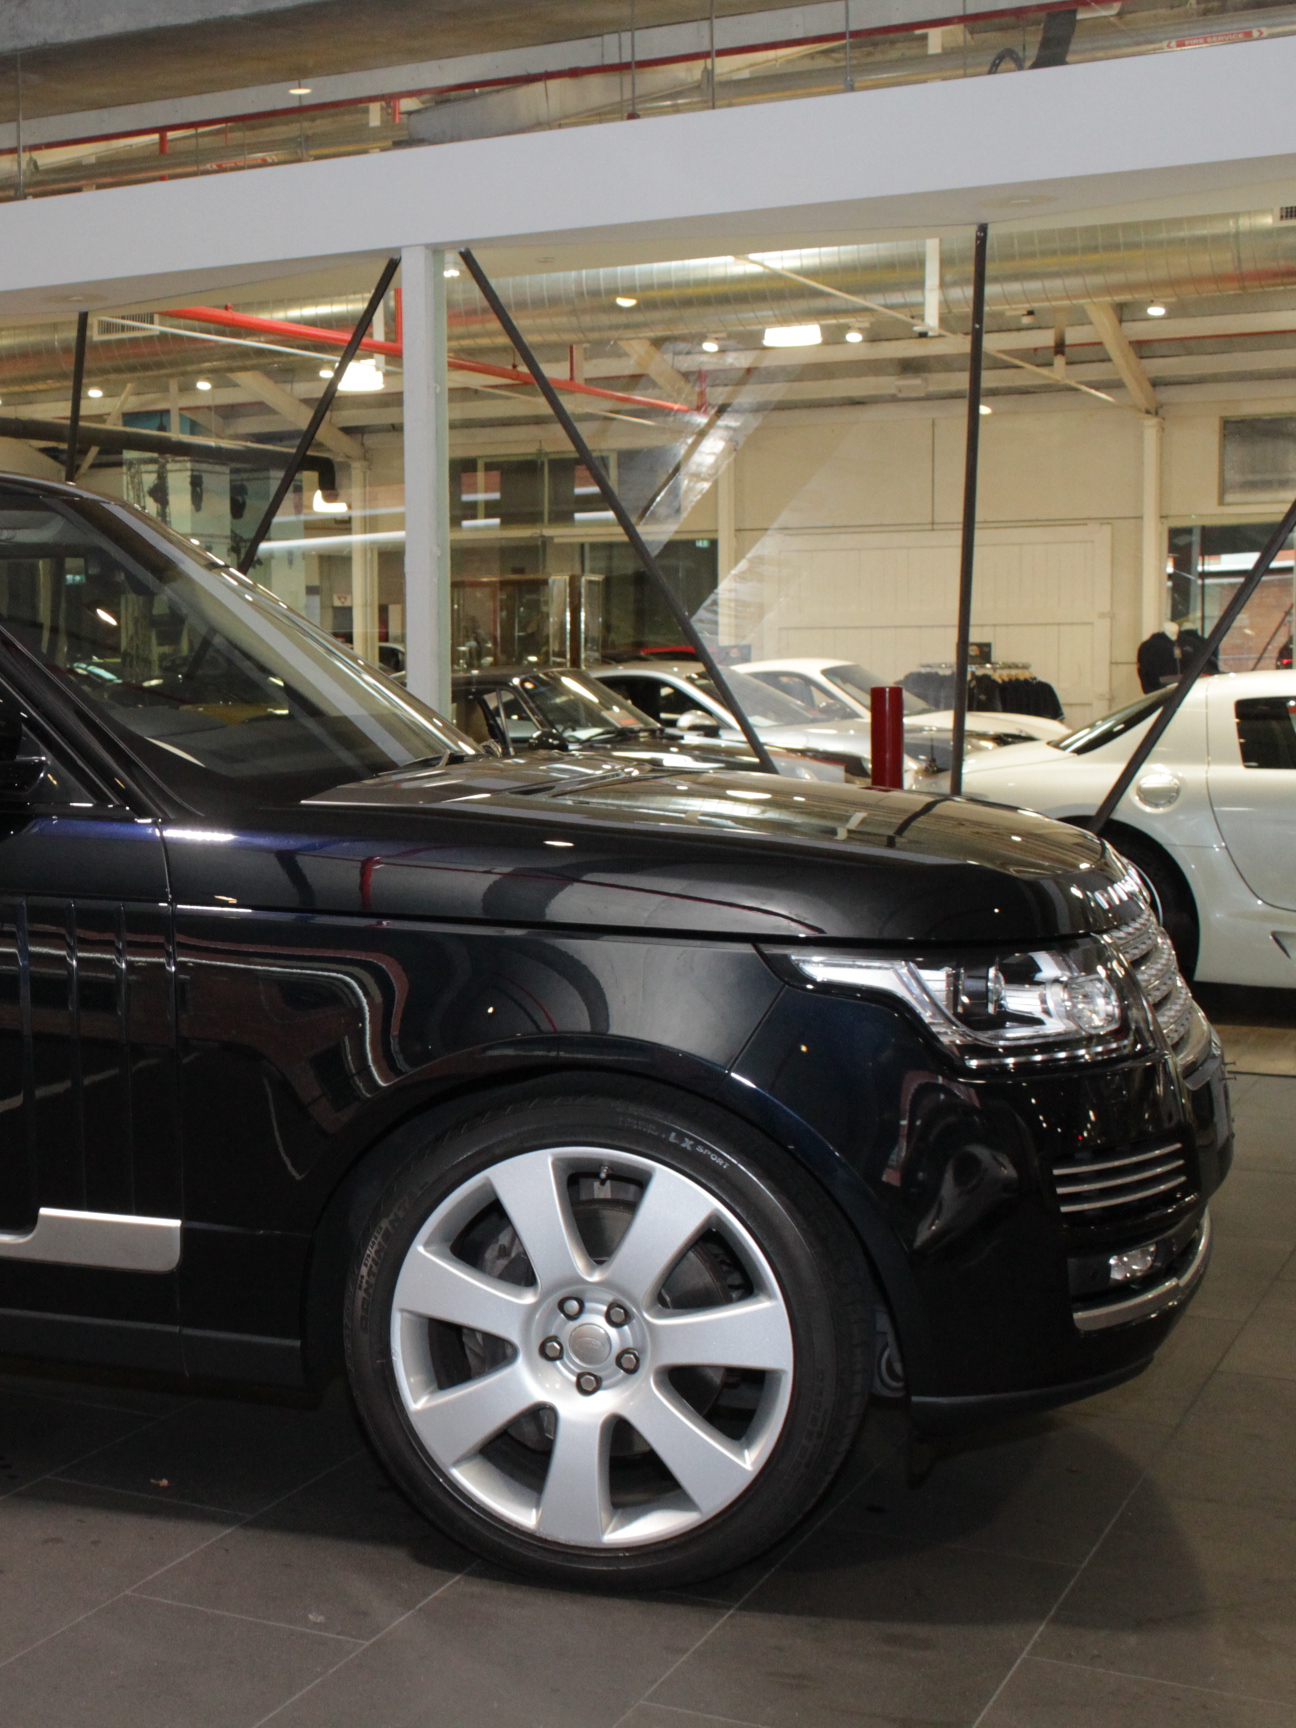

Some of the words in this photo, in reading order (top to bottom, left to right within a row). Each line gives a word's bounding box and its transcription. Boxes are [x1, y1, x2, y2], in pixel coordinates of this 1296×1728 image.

[1185, 38, 1203, 46] FIRE
[1206, 33, 1244, 43] SERVICE
[696, 1145, 729, 1169] SPORT
